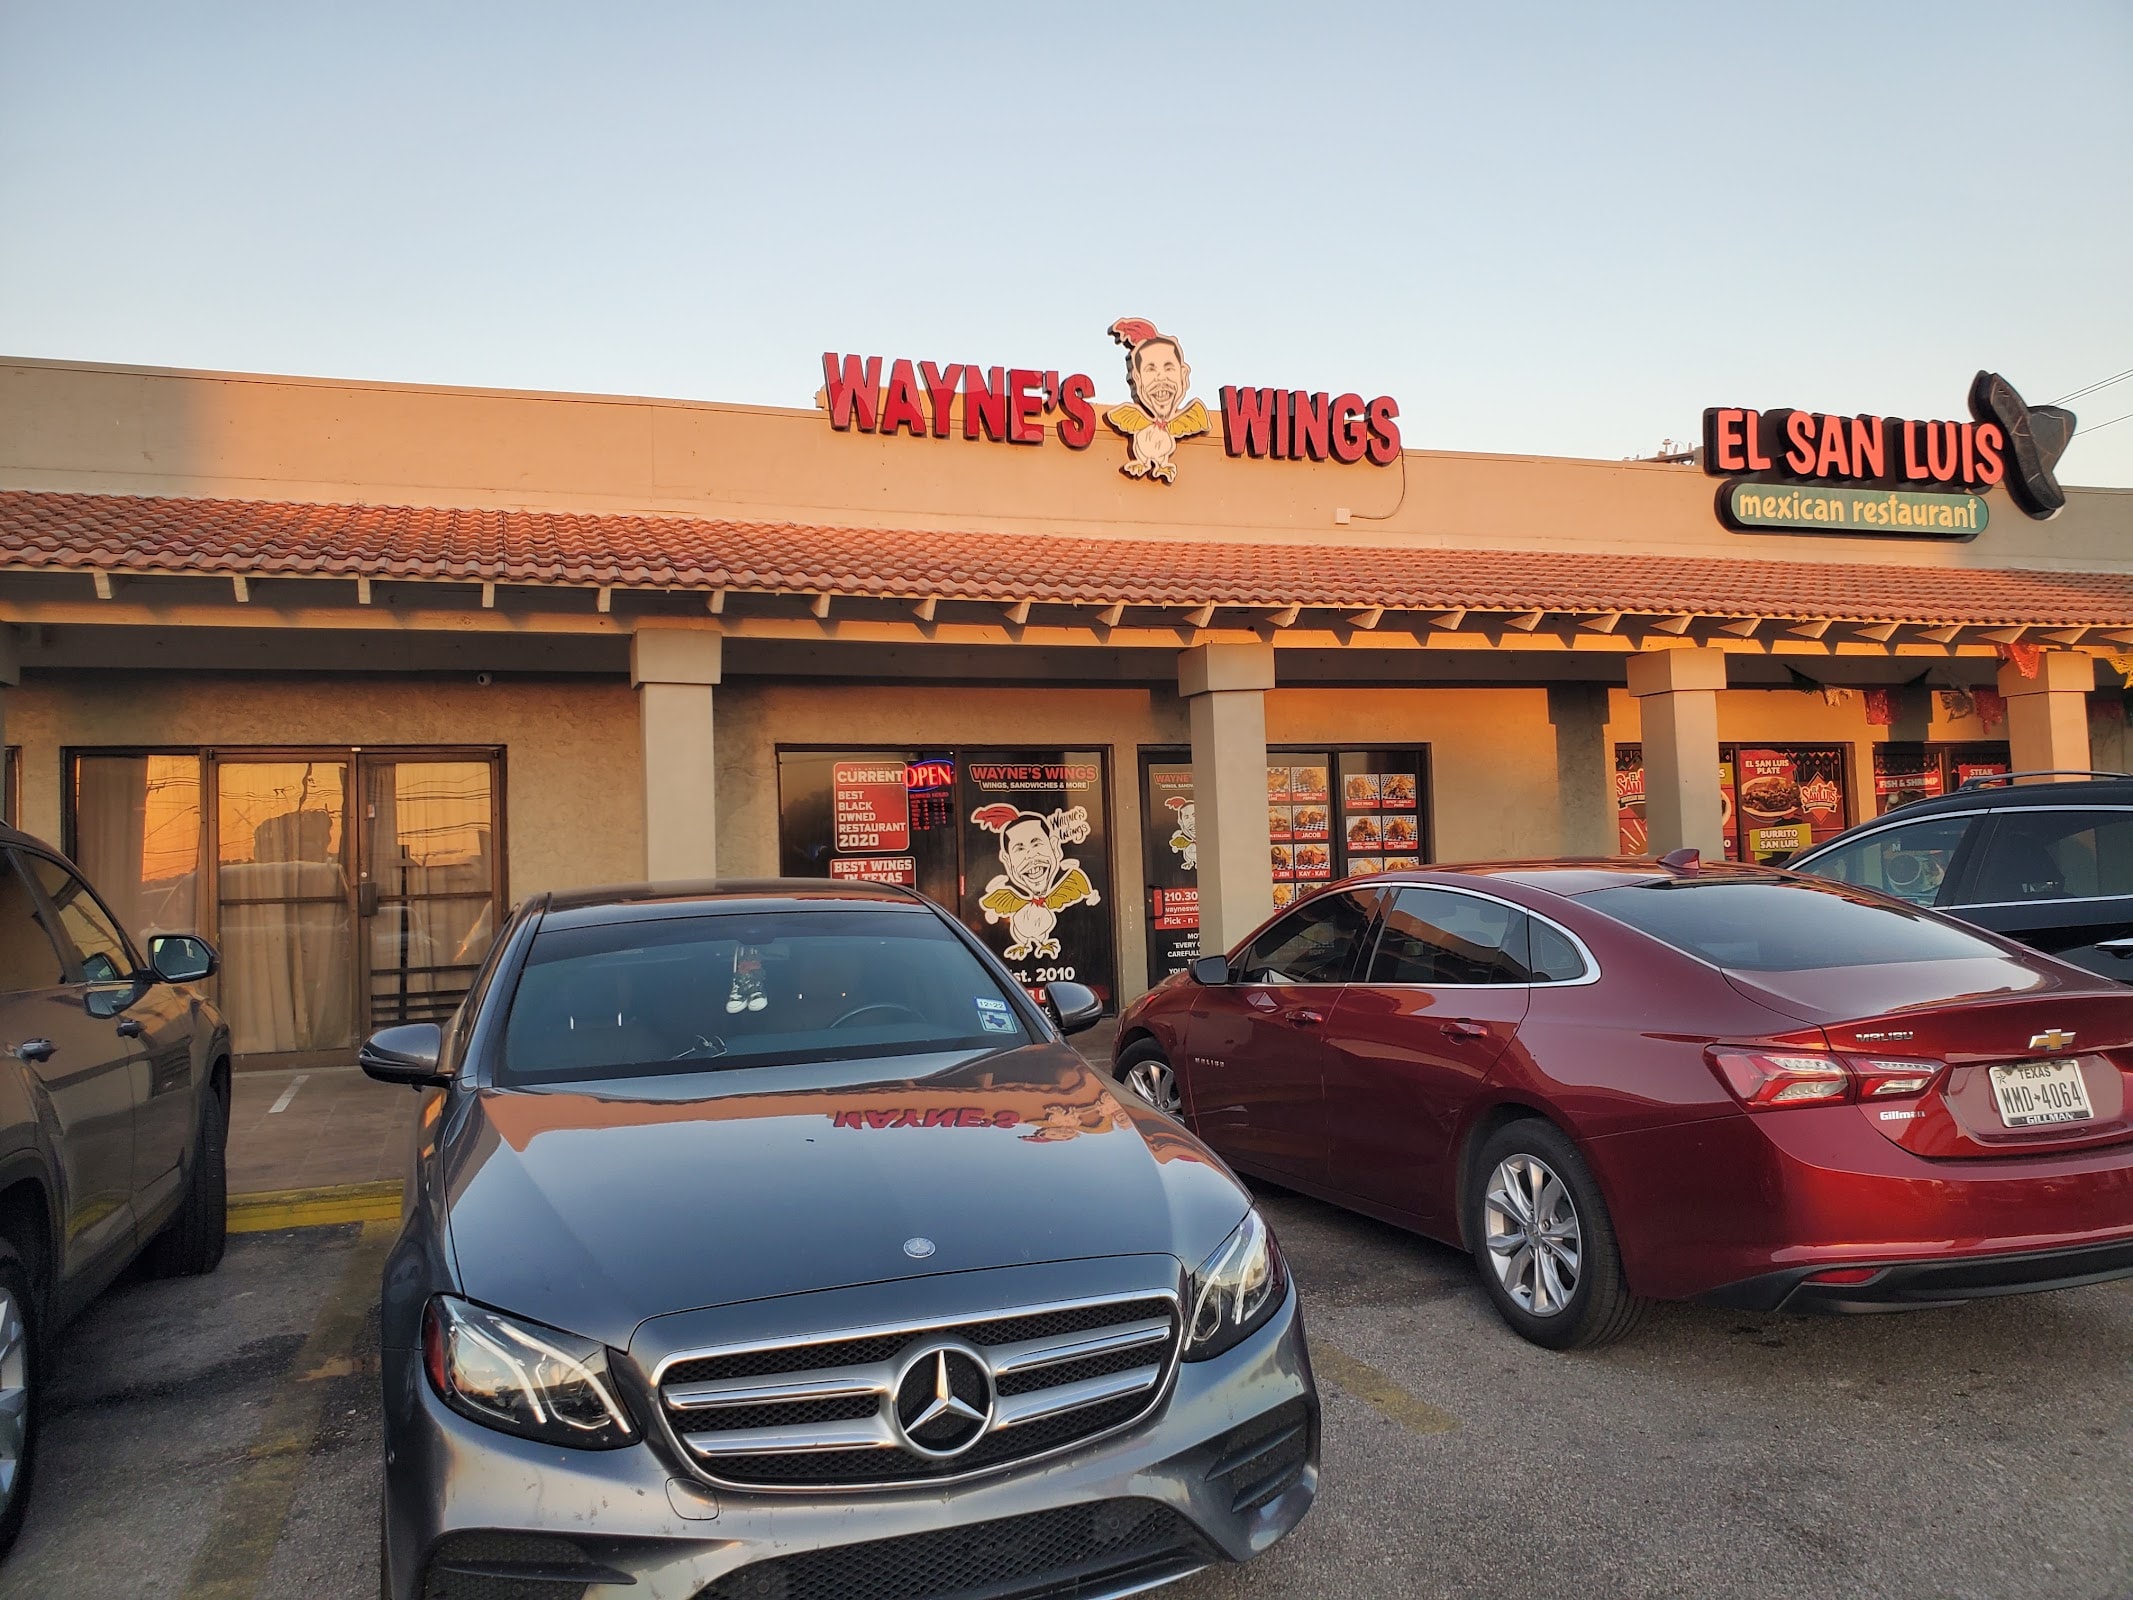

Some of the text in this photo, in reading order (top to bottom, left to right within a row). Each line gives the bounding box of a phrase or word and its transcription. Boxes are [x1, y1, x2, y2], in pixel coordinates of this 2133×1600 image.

[822, 352, 1400, 465] WAYNE'S WINGS
[1717, 409, 2005, 486] EL SAN LUIS
[1739, 491, 1977, 529] mexican restaurant
[837, 770, 904, 782] CURRENT
[902, 765, 952, 788] OPEN
[972, 766, 1096, 780] WAYNE'S WINGS
[1155, 775, 1193, 783] WAYNE
[1880, 778, 1938, 788] FISH & SHRIMP
[838, 791, 864, 800] BEST
[838, 801, 873, 811] BLACK
[838, 812, 876, 822] OWNED
[839, 822, 906, 833] RESTAURANT
[1760, 829, 1798, 839] BURRITO
[839, 834, 879, 848] 2020
[1760, 839, 1799, 849] SAN LUIS
[834, 859, 912, 873] BEST WINGS
[862, 872, 903, 883] TEXAS
[1164, 891, 1199, 902] 210.30
[1164, 917, 1181, 925] Pick
[1010, 966, 1075, 982] st. 2010
[1856, 1031, 1914, 1041] MALIBU
[2019, 1067, 2051, 1080] TEXAS
[2026, 1112, 2074, 1124] GILLMAN
